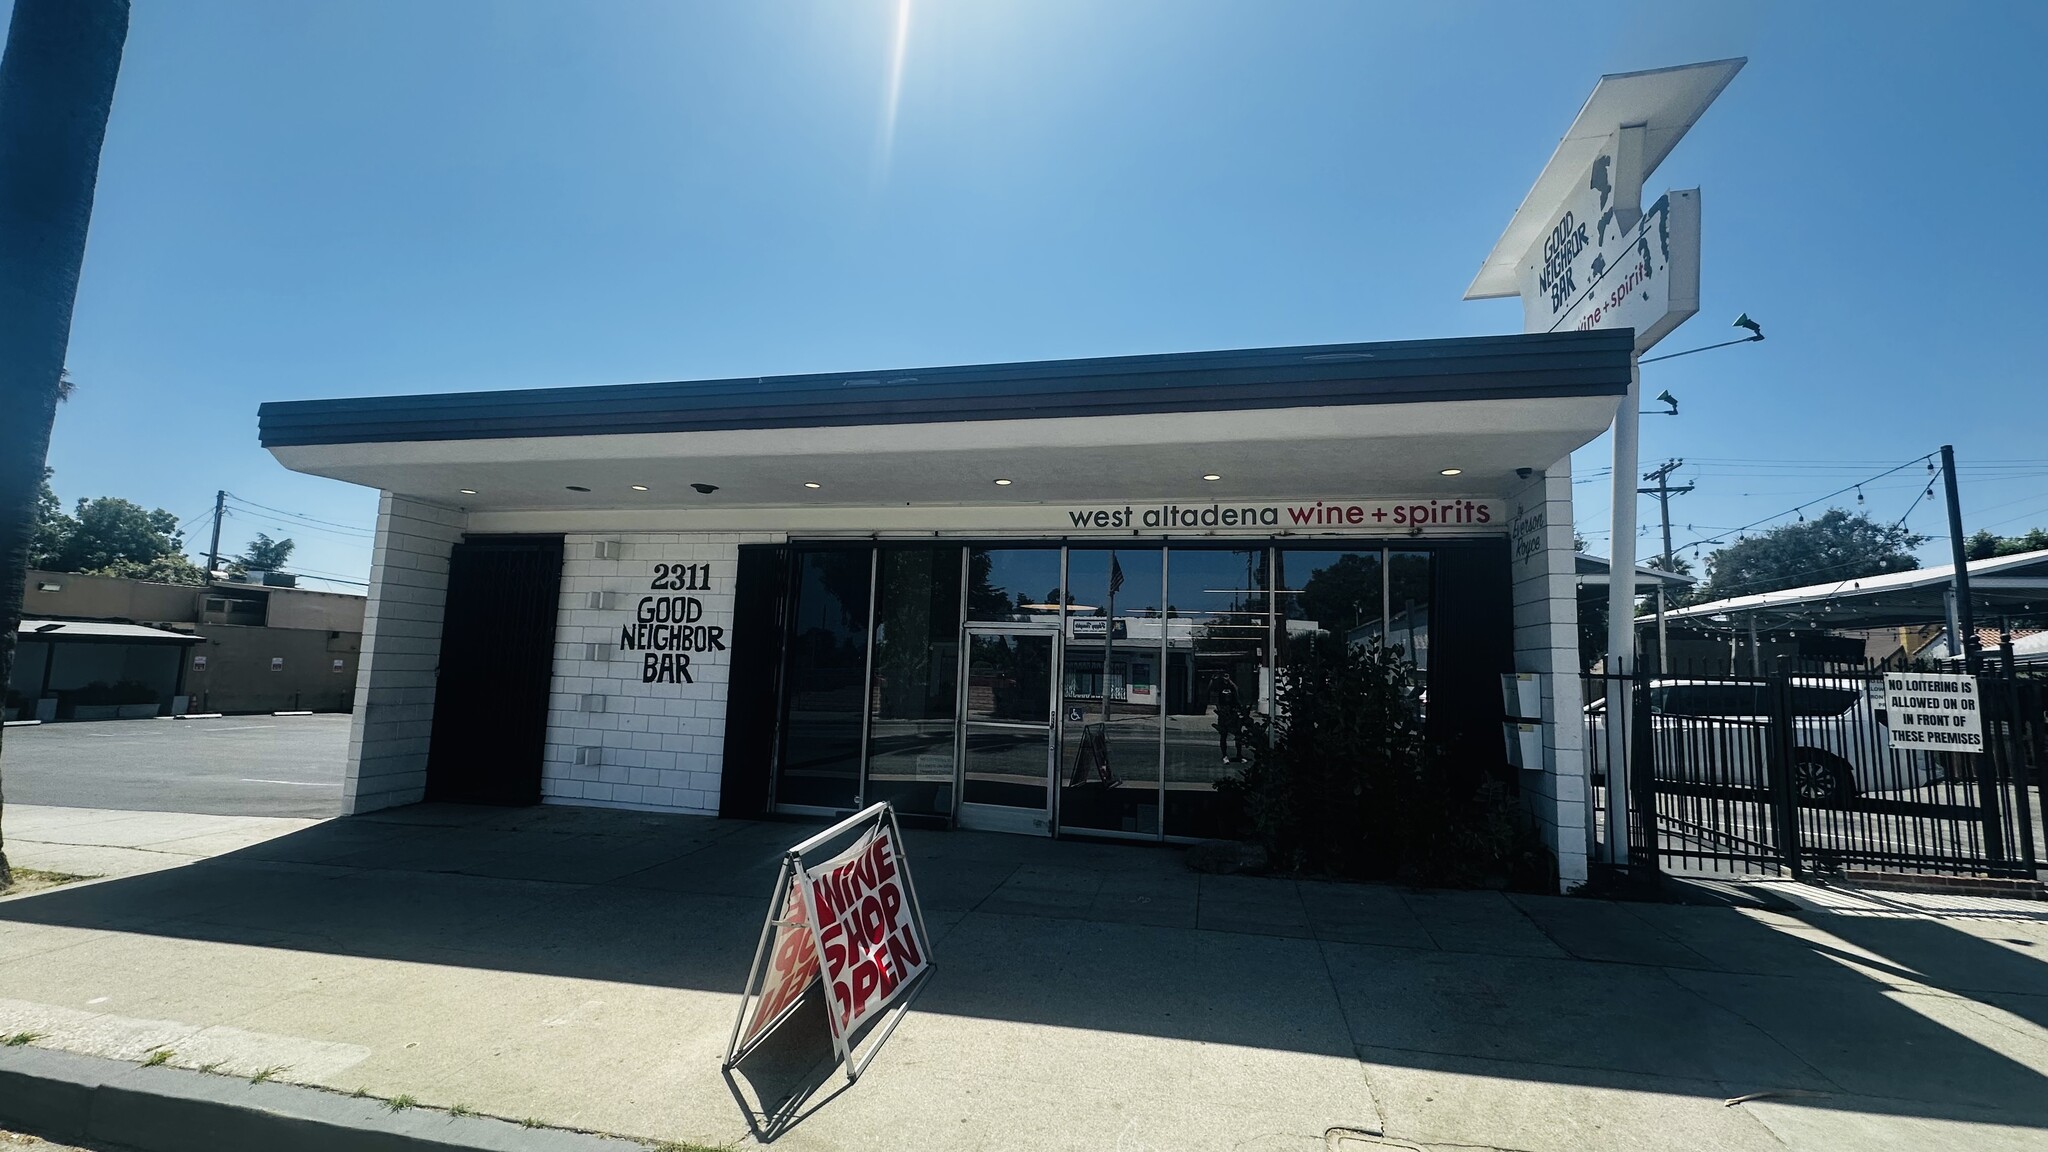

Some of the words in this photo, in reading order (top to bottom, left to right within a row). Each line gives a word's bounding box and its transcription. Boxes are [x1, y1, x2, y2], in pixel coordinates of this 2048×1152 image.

[1544, 211, 1573, 264] GOOD
[1539, 222, 1589, 297] NEIGHBOR
[1551, 266, 1576, 314] BAR
[1069, 507, 1133, 528] west
[1143, 505, 1278, 527] altadena
[1288, 502, 1364, 525] wine
[1393, 501, 1491, 527] spirits
[1513, 513, 1544, 539] Everson
[1516, 536, 1540, 565] Royce
[651, 563, 711, 590] 2311
[637, 596, 702, 623] GOOD
[620, 624, 726, 652] NEIGHBOR
[642, 652, 694, 684] BAR
[1888, 679, 1903, 691] NO
[1906, 680, 1958, 693] LOITERING
[1961, 682, 1972, 693] IS
[1891, 696, 1940, 709] ALLOWED
[1943, 698, 1958, 710] ON
[1961, 699, 1975, 710] OR
[1903, 713, 1914, 725] IN
[1917, 714, 1949, 726] FRONT
[1953, 716, 1966, 727] OF
[1892, 730, 1925, 743] THESE
[1927, 732, 1981, 745] PREMISES
[820, 882, 901, 983] SHOP
